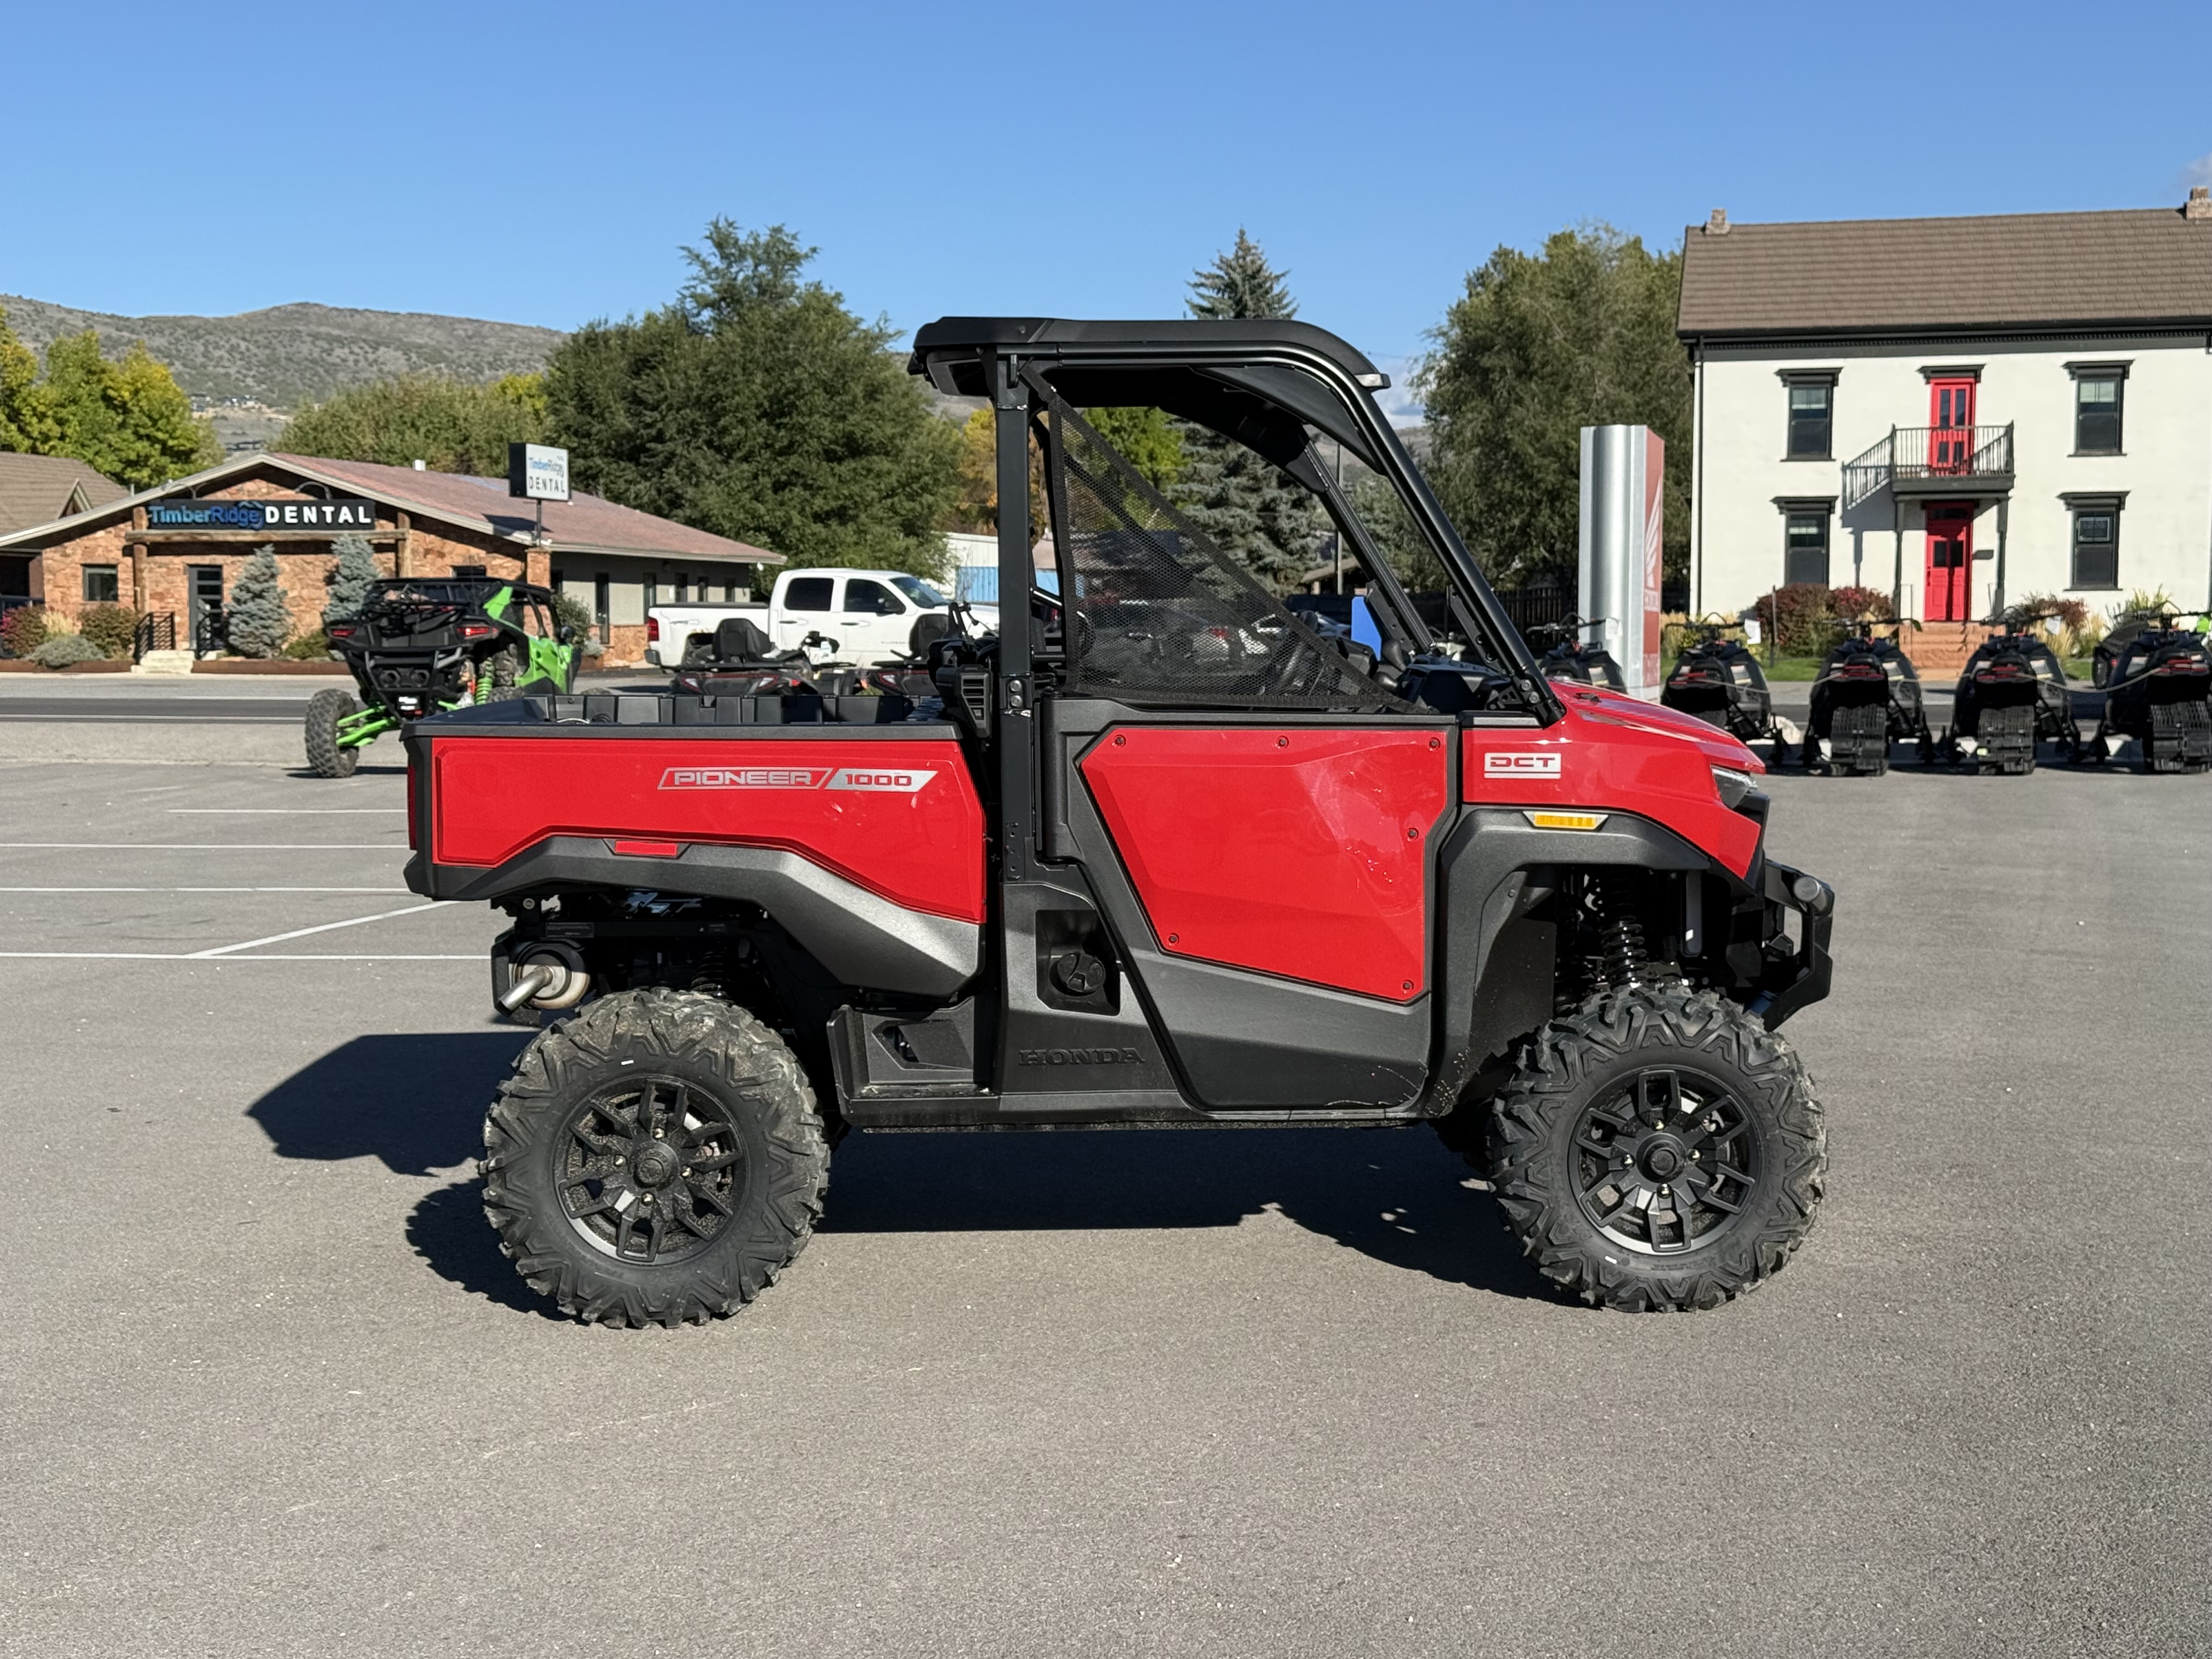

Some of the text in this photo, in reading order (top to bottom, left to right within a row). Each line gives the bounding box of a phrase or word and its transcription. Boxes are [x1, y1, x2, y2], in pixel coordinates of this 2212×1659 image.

[529, 476, 565, 493] DENTAL
[148, 505, 371, 529] TimberRidge DENTAL
[1489, 757, 1555, 768] DCT
[674, 771, 912, 786] PIONEER 1000
[1019, 1047, 1146, 1066] HONDA
